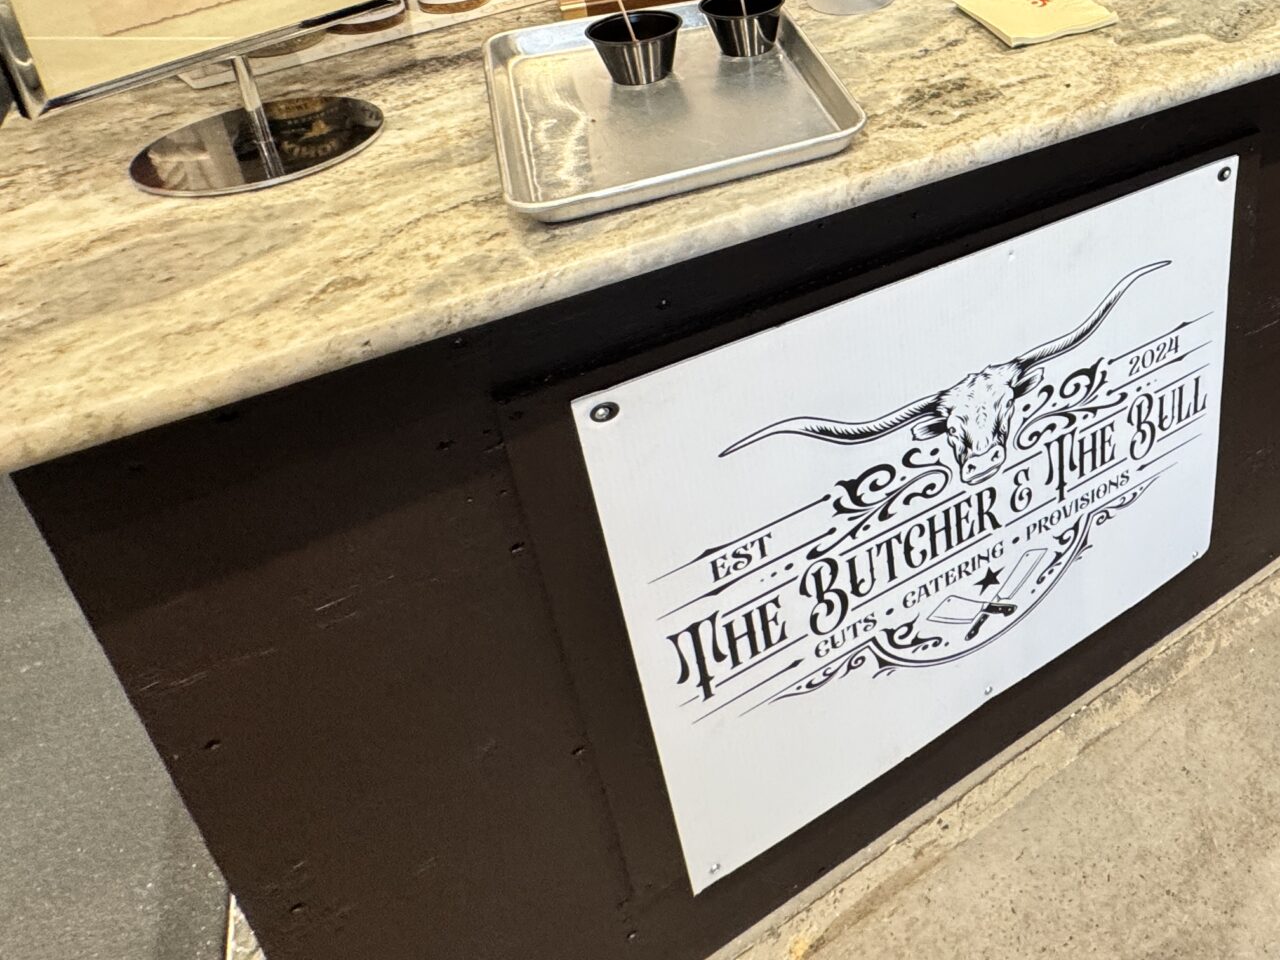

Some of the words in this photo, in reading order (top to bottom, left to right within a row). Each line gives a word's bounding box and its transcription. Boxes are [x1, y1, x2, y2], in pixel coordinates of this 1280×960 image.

[1128, 335, 1181, 377] 2024
[666, 595, 788, 702] THE
[799, 486, 1004, 637] BUTCHER
[1010, 468, 1034, 513] &
[1044, 420, 1117, 504] THE
[1127, 375, 1208, 461] BULL
[709, 532, 775, 583] EST
[814, 612, 878, 660] CUTS
[902, 540, 1005, 610] CATERING
[1025, 469, 1131, 542] PROVISIONS
